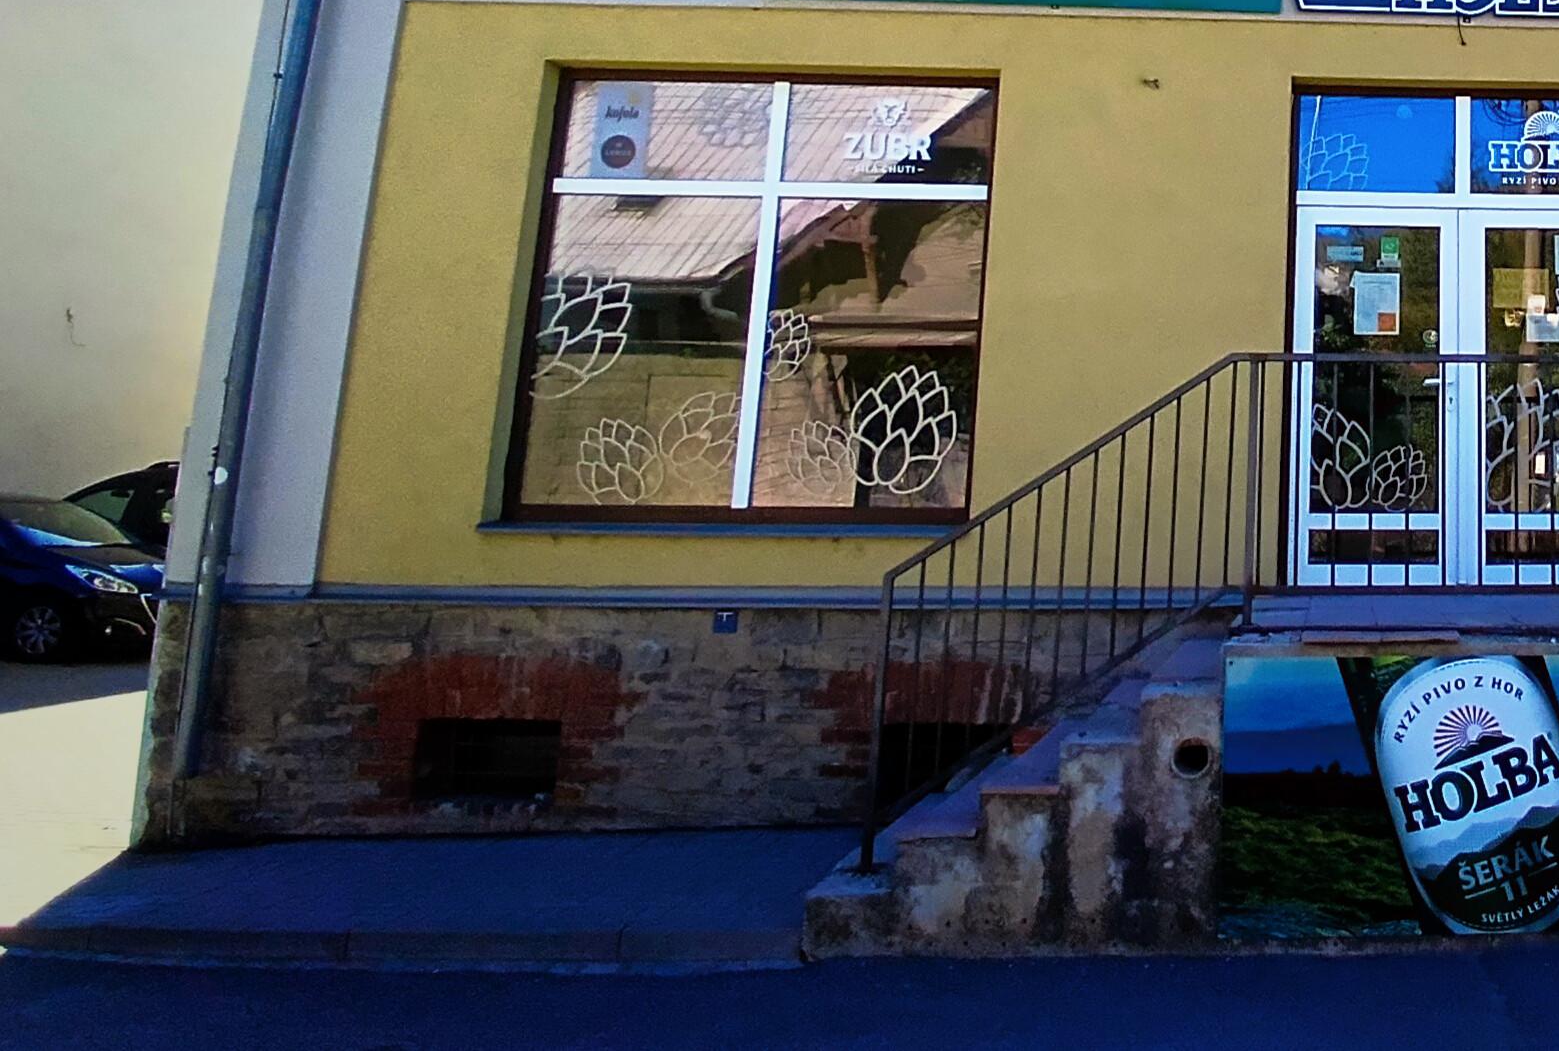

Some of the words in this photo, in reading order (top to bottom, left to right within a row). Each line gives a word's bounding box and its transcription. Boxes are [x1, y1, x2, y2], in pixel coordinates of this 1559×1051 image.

[843, 132, 932, 162] ZUBR
[1531, 177, 1557, 185] PIVO
[1393, 701, 1421, 744] RYZÍ
[1422, 676, 1466, 706] PIVO
[1474, 675, 1484, 688] Z
[1491, 676, 1525, 702] HOR
[1457, 834, 1555, 891] ŠERÁK
[1500, 875, 1528, 902] 11
